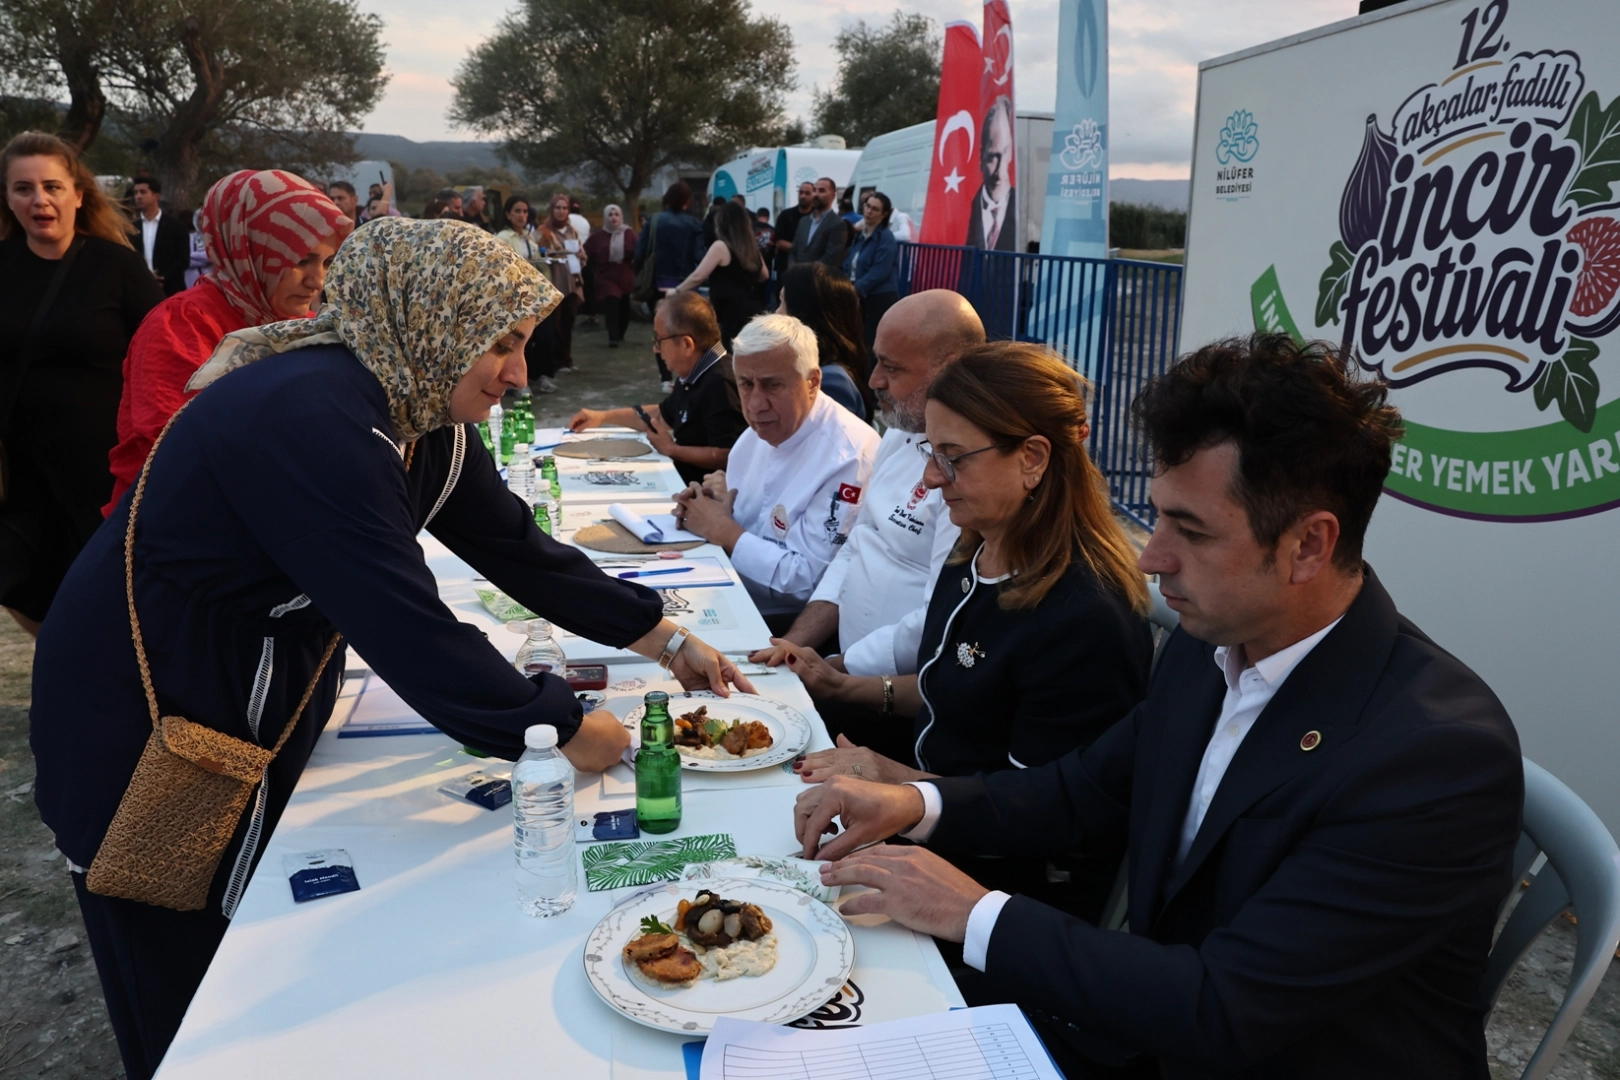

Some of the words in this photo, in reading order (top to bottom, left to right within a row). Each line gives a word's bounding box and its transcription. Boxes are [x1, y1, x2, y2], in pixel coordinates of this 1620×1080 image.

[1452, 0, 1510, 70] 12.
[1215, 181, 1253, 194] BELEDİYESİ
[1216, 166, 1254, 181] NİLÜFER
[1380, 121, 1575, 267] incir
[1340, 239, 1579, 366] festivali
[1390, 443, 1423, 482] ER
[1430, 454, 1536, 495] YEMEK
